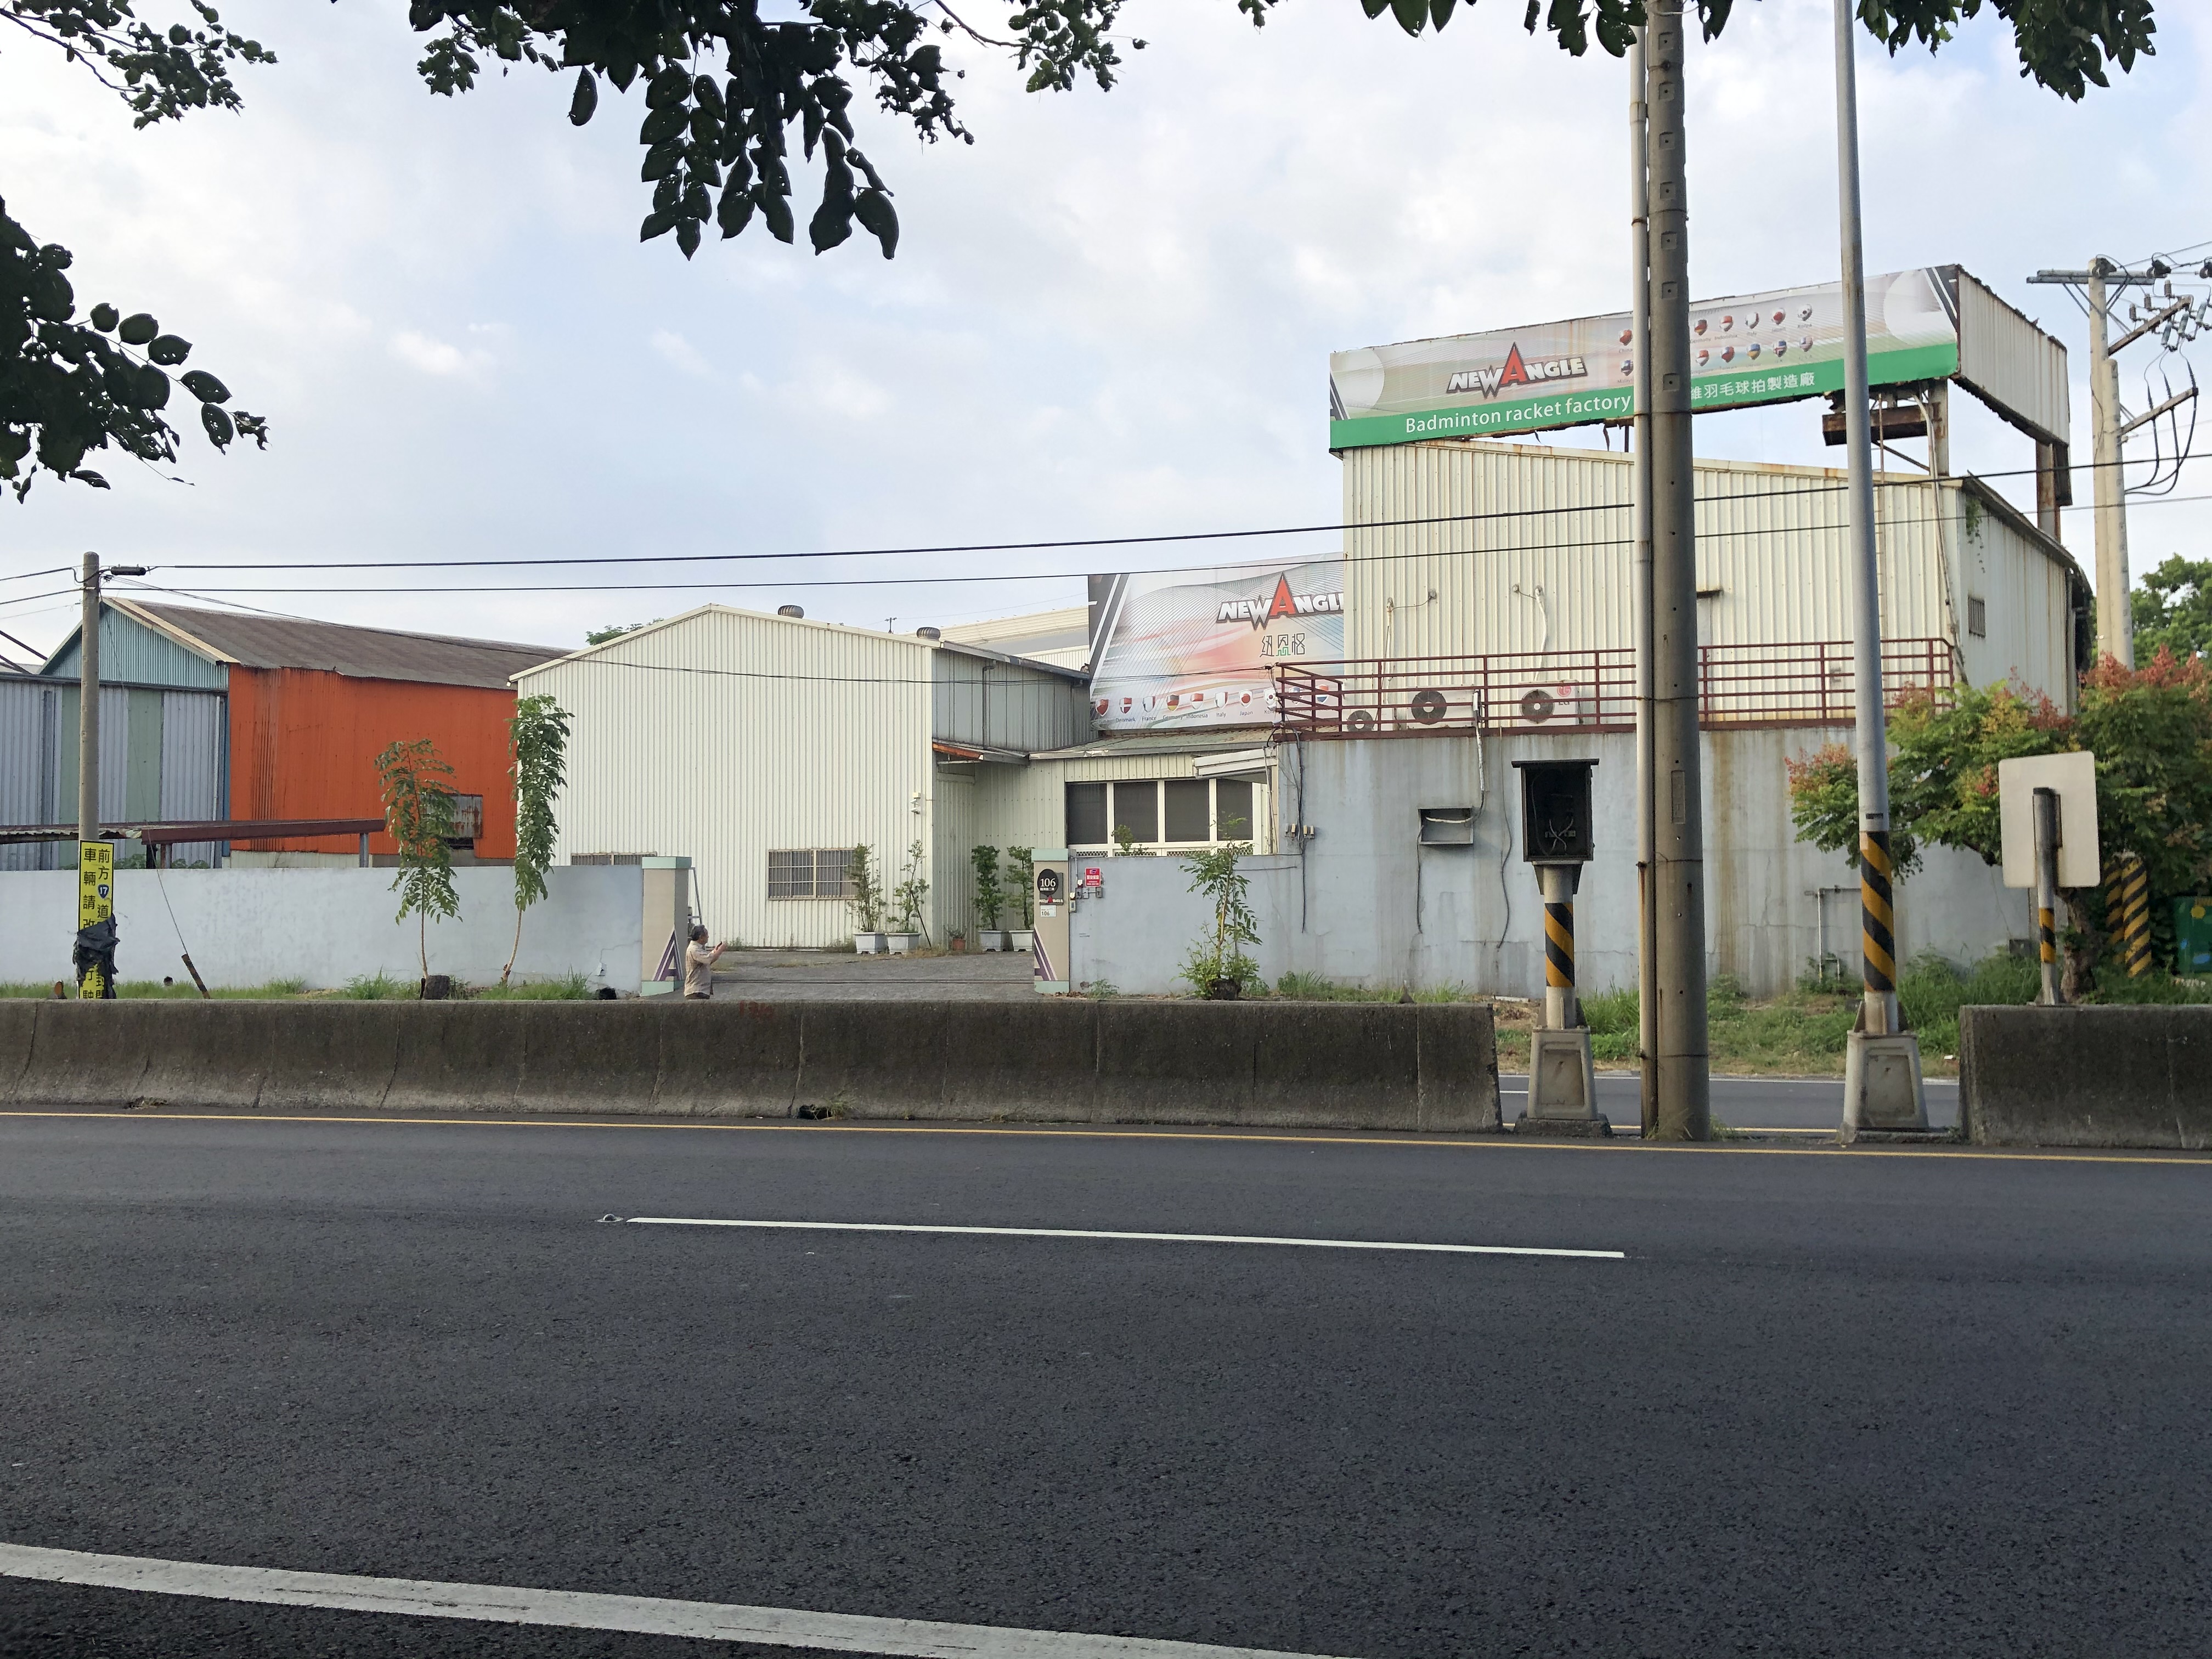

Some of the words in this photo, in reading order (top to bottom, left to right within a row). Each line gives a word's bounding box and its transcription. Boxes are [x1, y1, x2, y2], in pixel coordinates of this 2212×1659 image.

[1446, 342, 1588, 399] NEWANGLE
[1406, 411, 1500, 433] Badminton
[1506, 402, 1561, 422] racket
[1565, 395, 1632, 414] factory
[1216, 571, 1344, 631] NEWANGL
[1040, 878, 1056, 887] 106
